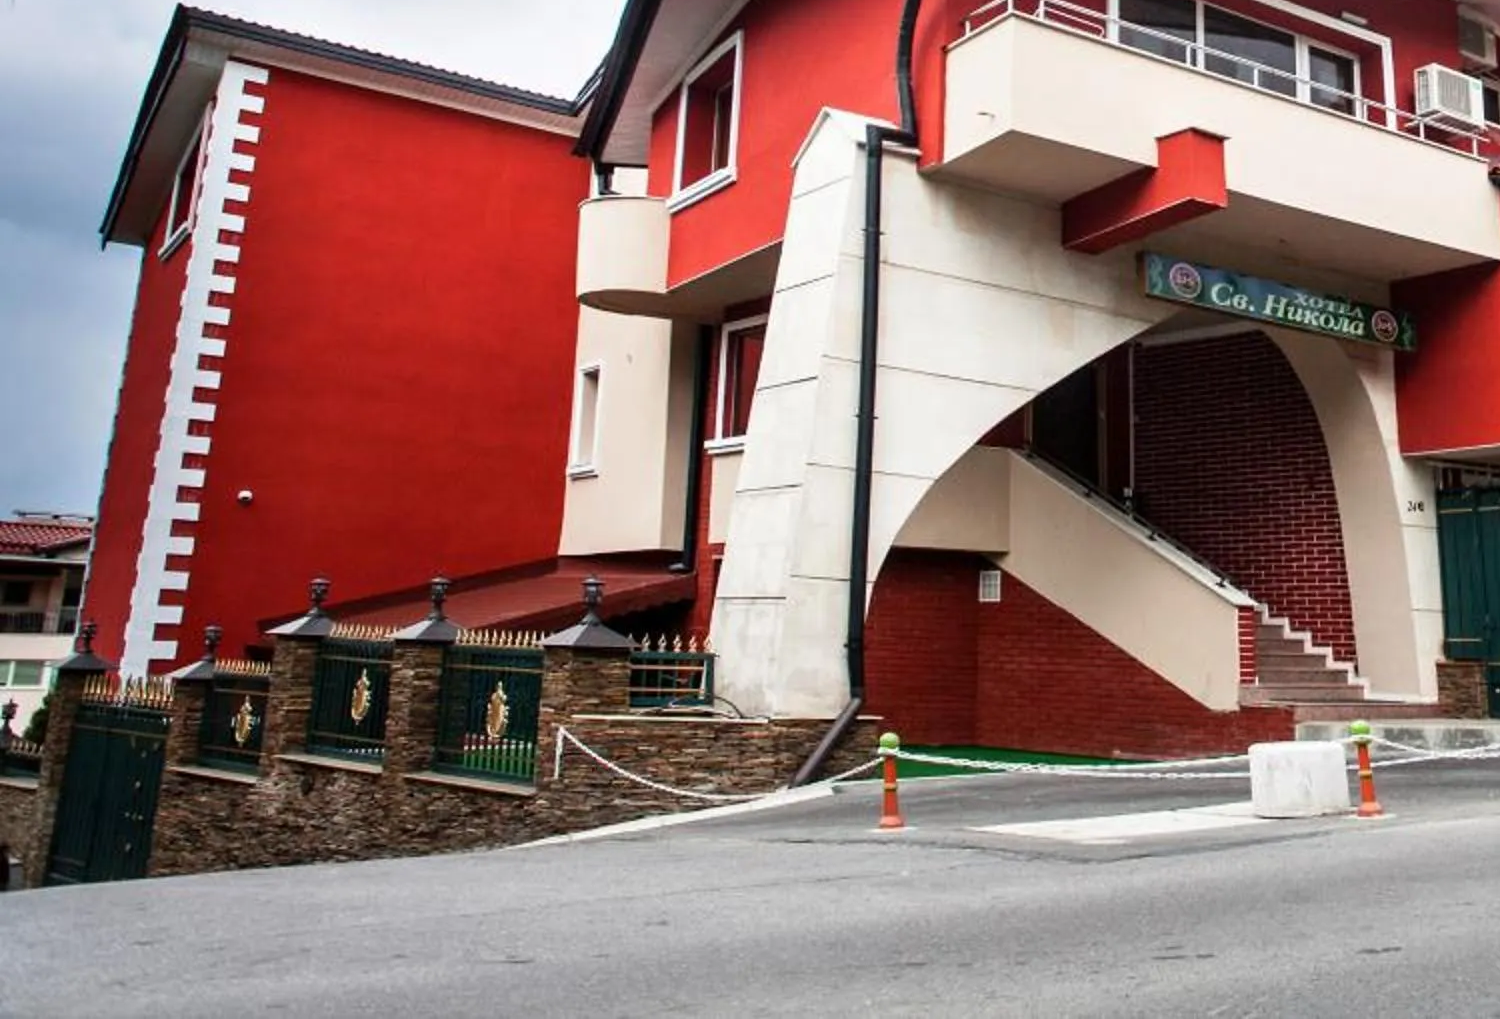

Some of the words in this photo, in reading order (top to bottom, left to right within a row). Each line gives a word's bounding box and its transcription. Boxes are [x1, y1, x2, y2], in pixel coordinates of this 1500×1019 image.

[1210, 282, 1255, 312] Св.
[1262, 294, 1365, 336] Никола
[1294, 292, 1364, 319] ХОТЕЛ
